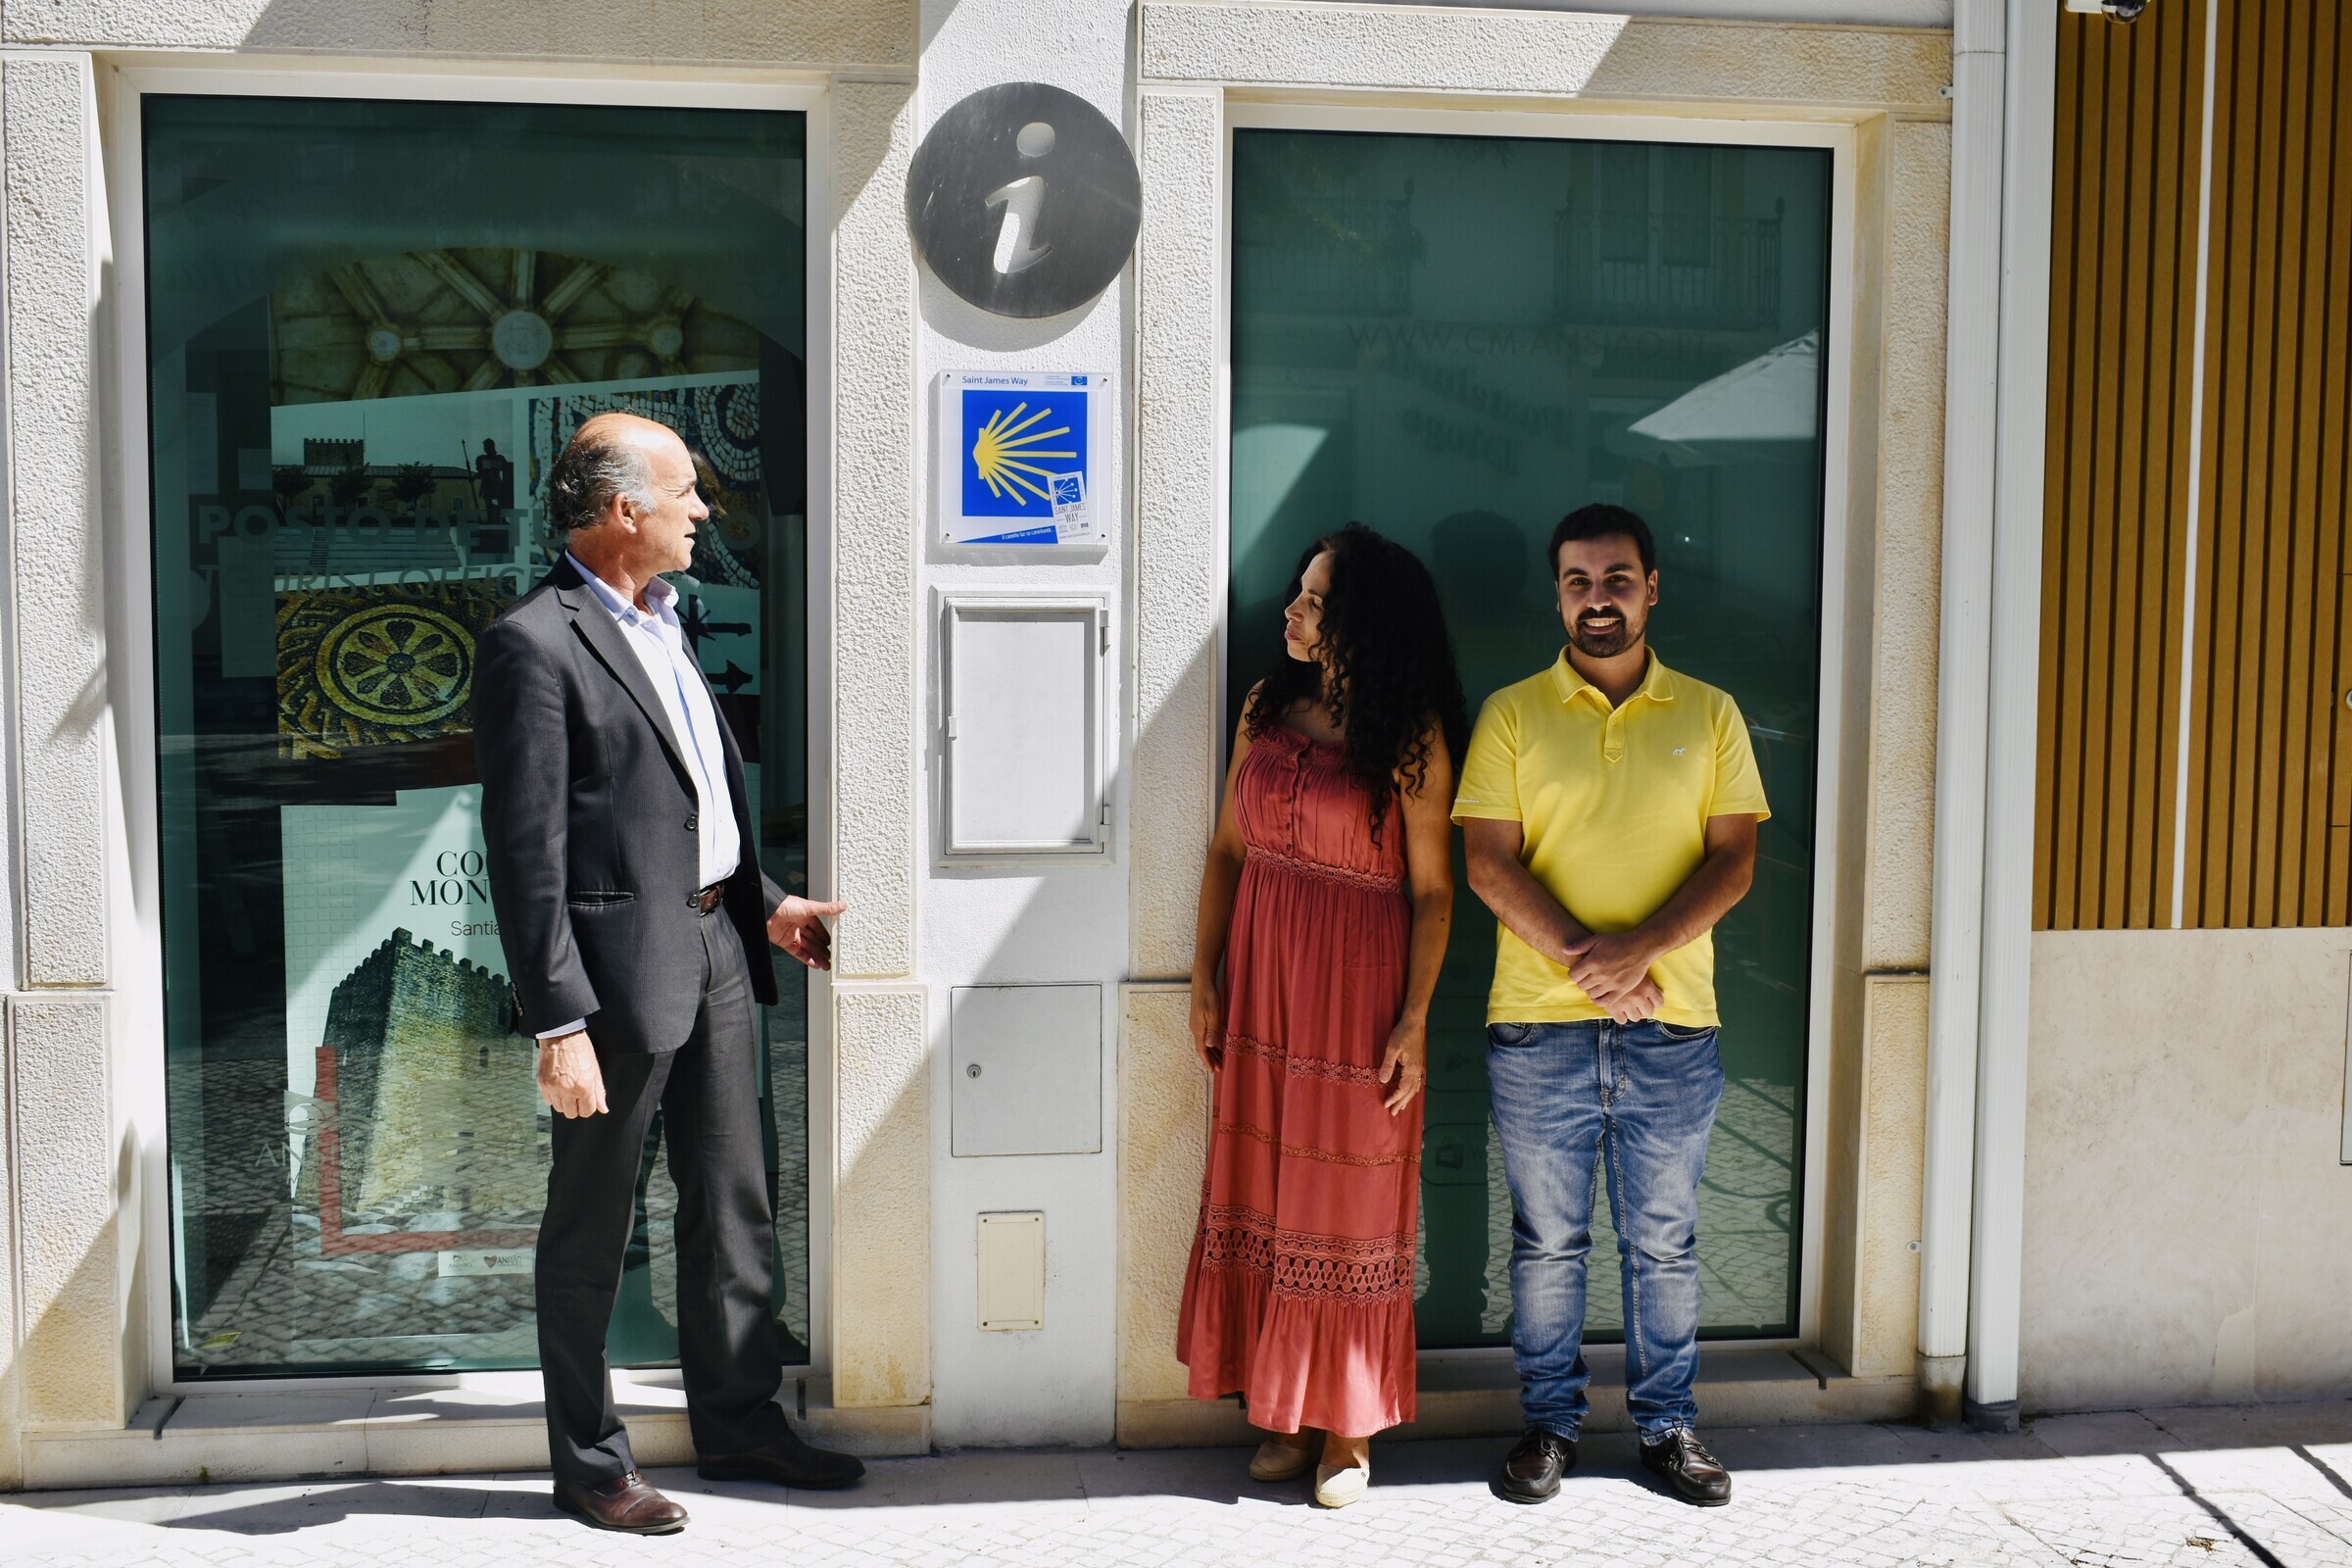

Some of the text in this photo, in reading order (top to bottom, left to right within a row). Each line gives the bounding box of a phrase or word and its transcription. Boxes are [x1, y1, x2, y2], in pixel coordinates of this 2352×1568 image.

[962, 375, 983, 384] Saint
[1010, 377, 1029, 386] Way
[1054, 502, 1087, 514] SAINT JAMES
[1065, 513, 1079, 523] WAY
[199, 504, 392, 546] POSTO
[415, 507, 483, 547] DE
